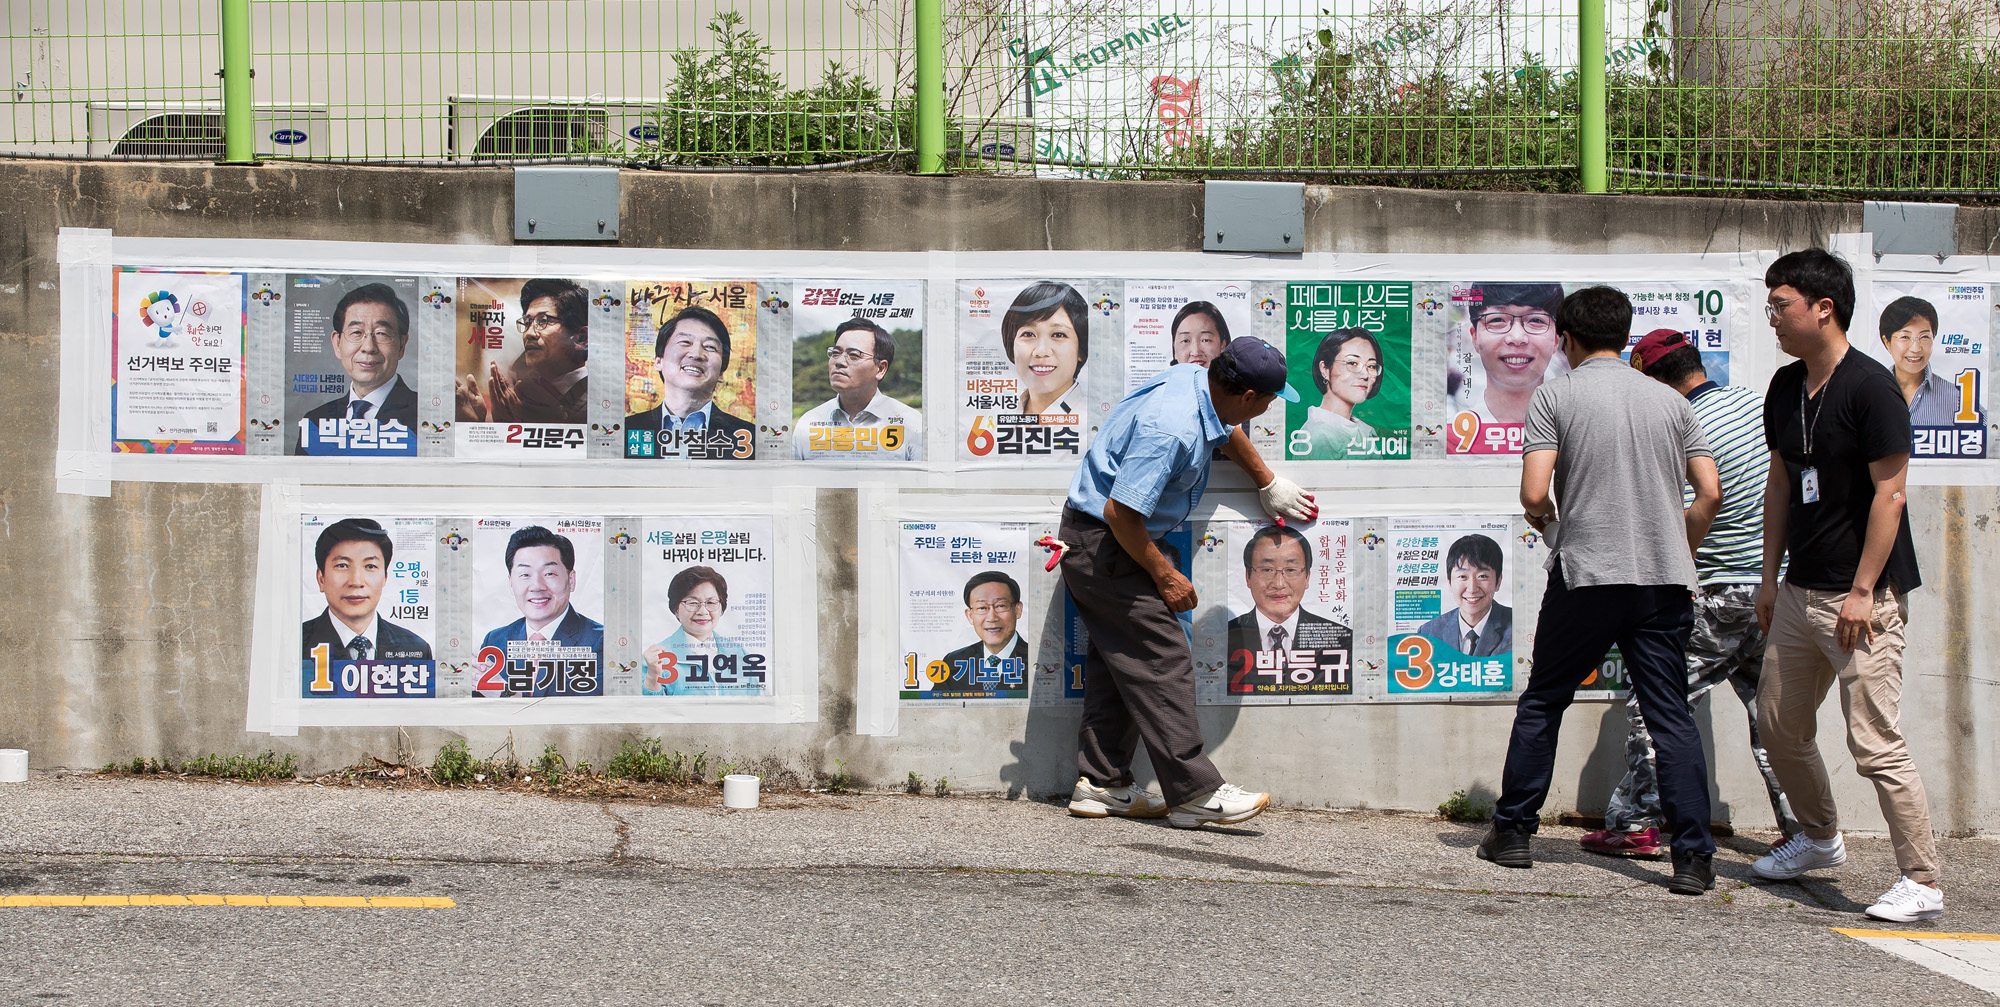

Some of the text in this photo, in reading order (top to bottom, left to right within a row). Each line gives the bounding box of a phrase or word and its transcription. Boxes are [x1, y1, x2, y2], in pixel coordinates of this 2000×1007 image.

[709, 287, 748, 308] 서울
[868, 293, 894, 305] 서울
[1290, 285, 1409, 307] 페미니스트
[1633, 293, 1654, 301] 가능한
[1658, 293, 1672, 301] 녹색
[1675, 293, 1690, 301] 청정
[1694, 290, 1723, 315] 10
[470, 311, 505, 326] 바꾸자
[889, 308, 913, 318] 교체!
[1290, 310, 1387, 332] 서울시장
[1632, 306, 1678, 315] 특별시장 후보
[192, 337, 222, 347] 안 돼요!
[468, 327, 504, 349] 서울
[1942, 334, 1969, 345] 내일을
[1972, 343, 1981, 354] 힘
[127, 355, 232, 373] 선거벽보 주의문
[293, 374, 345, 383] 시대와 나란히
[293, 384, 345, 393] 시민과 나란히
[967, 379, 1018, 393] 비정규직
[966, 396, 1018, 409] 서울시장
[1954, 368, 1980, 424] 1
[298, 418, 408, 449] 1 박원순
[506, 425, 523, 443] 2
[523, 428, 584, 449] 김문수
[629, 431, 653, 442] 서울
[809, 427, 898, 451] 김종민 5
[967, 416, 1079, 456] 6 김진숙
[1453, 410, 1525, 452] 9 우인
[629, 444, 653, 456] 살림
[657, 429, 753, 458] 안철수 3
[1289, 430, 1408, 455] 8 신지예
[1914, 430, 1982, 455] 김미경
[647, 531, 750, 545] 서울살림 은평살림
[914, 537, 982, 549] 주민을 섬기는
[663, 548, 766, 562] 바꿔야 바뀝니다.
[950, 551, 1016, 563] 든든한 일꾼!!
[393, 561, 429, 578] 은평이
[1318, 535, 1331, 602] 함께 꿈꾸는
[1335, 535, 1347, 603] 새로운 변화
[400, 589, 419, 604] 1등
[390, 606, 429, 619] 시의원
[310, 643, 430, 694] 1 이현찬
[477, 646, 598, 692] 2 남기정
[657, 651, 766, 684] 3 고연옥
[904, 652, 1025, 690] 1 가 기노만
[1230, 649, 1350, 692] 2 박등규
[1395, 635, 1434, 690] 3
[1436, 660, 1506, 687] 강태훈
[1072, 664, 1083, 689] 1
